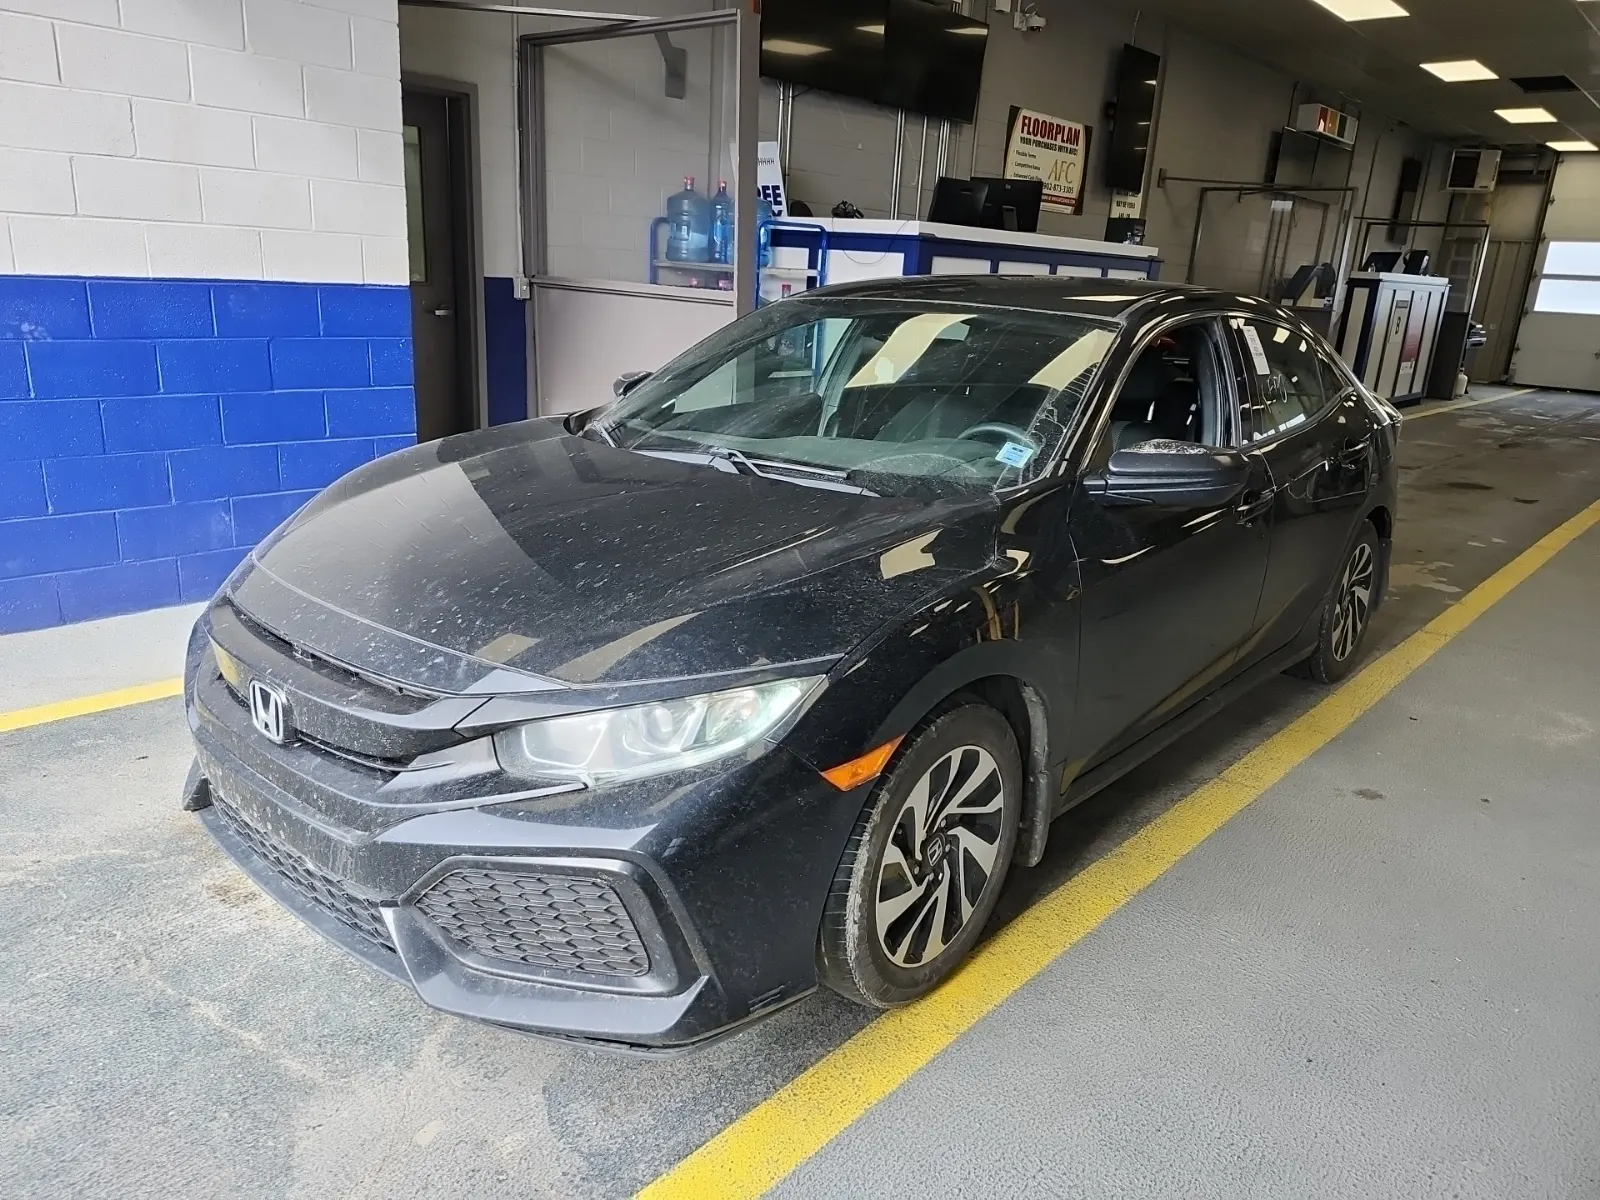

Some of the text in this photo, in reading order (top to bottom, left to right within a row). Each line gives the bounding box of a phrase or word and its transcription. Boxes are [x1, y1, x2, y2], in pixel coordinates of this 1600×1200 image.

[1021, 115, 1081, 147] FLOORPLAN
[1020, 136, 1032, 146] YOUR
[1032, 139, 1058, 152] PURCHASES
[1058, 144, 1068, 154] WITH
[1048, 158, 1076, 184] AFC
